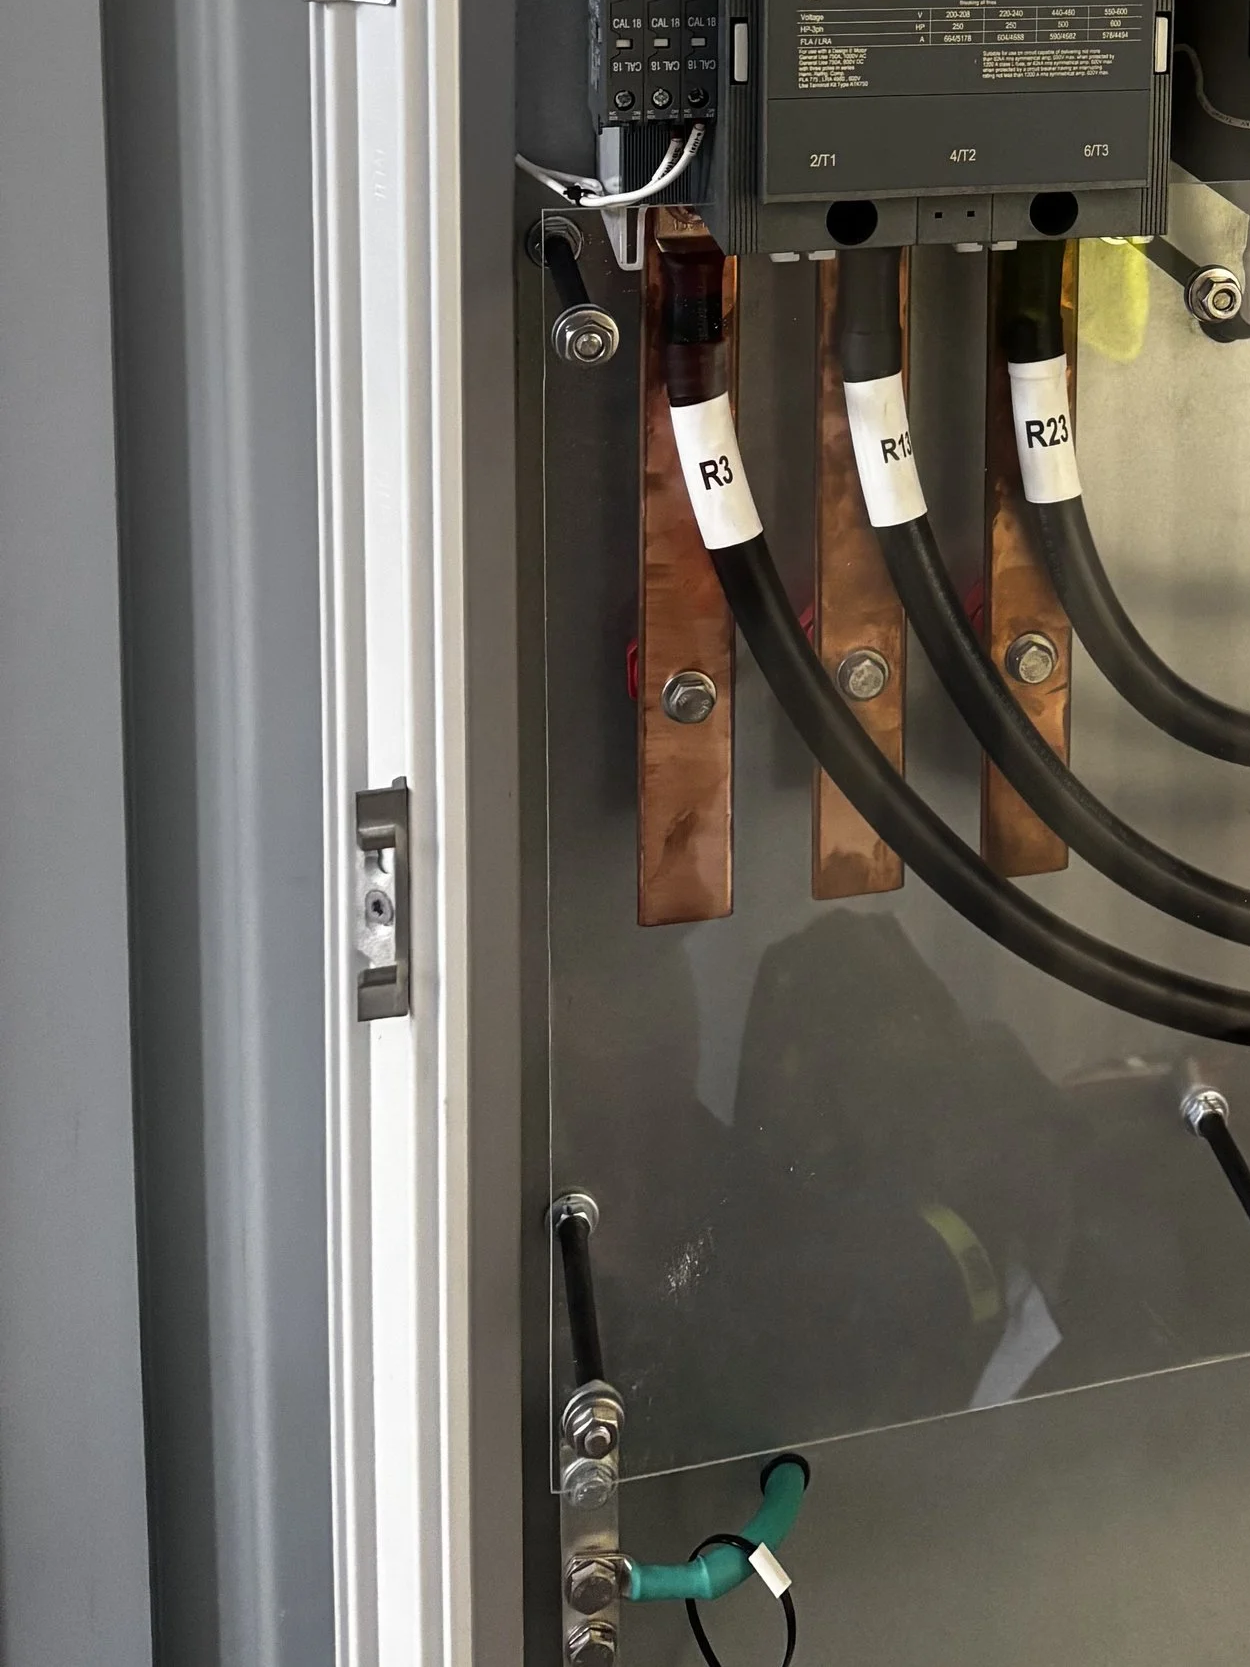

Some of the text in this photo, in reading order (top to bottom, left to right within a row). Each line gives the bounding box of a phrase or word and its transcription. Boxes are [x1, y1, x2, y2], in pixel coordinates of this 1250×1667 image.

[800, 14, 824, 22] Voltage
[946, 10, 971, 18] 200-208
[999, 9, 1024, 18] 220-240
[1051, 9, 1076, 17] 440-480
[1104, 7, 1128, 15] 550-600
[613, 19, 641, 28] CAL 18
[651, 18, 680, 28] CAL 18
[688, 17, 716, 27] CAL 18
[952, 22, 964, 30] 250
[1005, 21, 1017, 29] 250
[613, 61, 642, 72] CAL 18
[651, 61, 680, 71] CAL 18
[698, 59, 716, 70] CAL
[949, 149, 976, 162] 4/T2
[1084, 145, 1109, 158] 6/T3
[810, 154, 836, 167] 2/T1
[1025, 414, 1070, 448] R23
[880, 430, 912, 464] R13
[699, 456, 734, 491] R3
